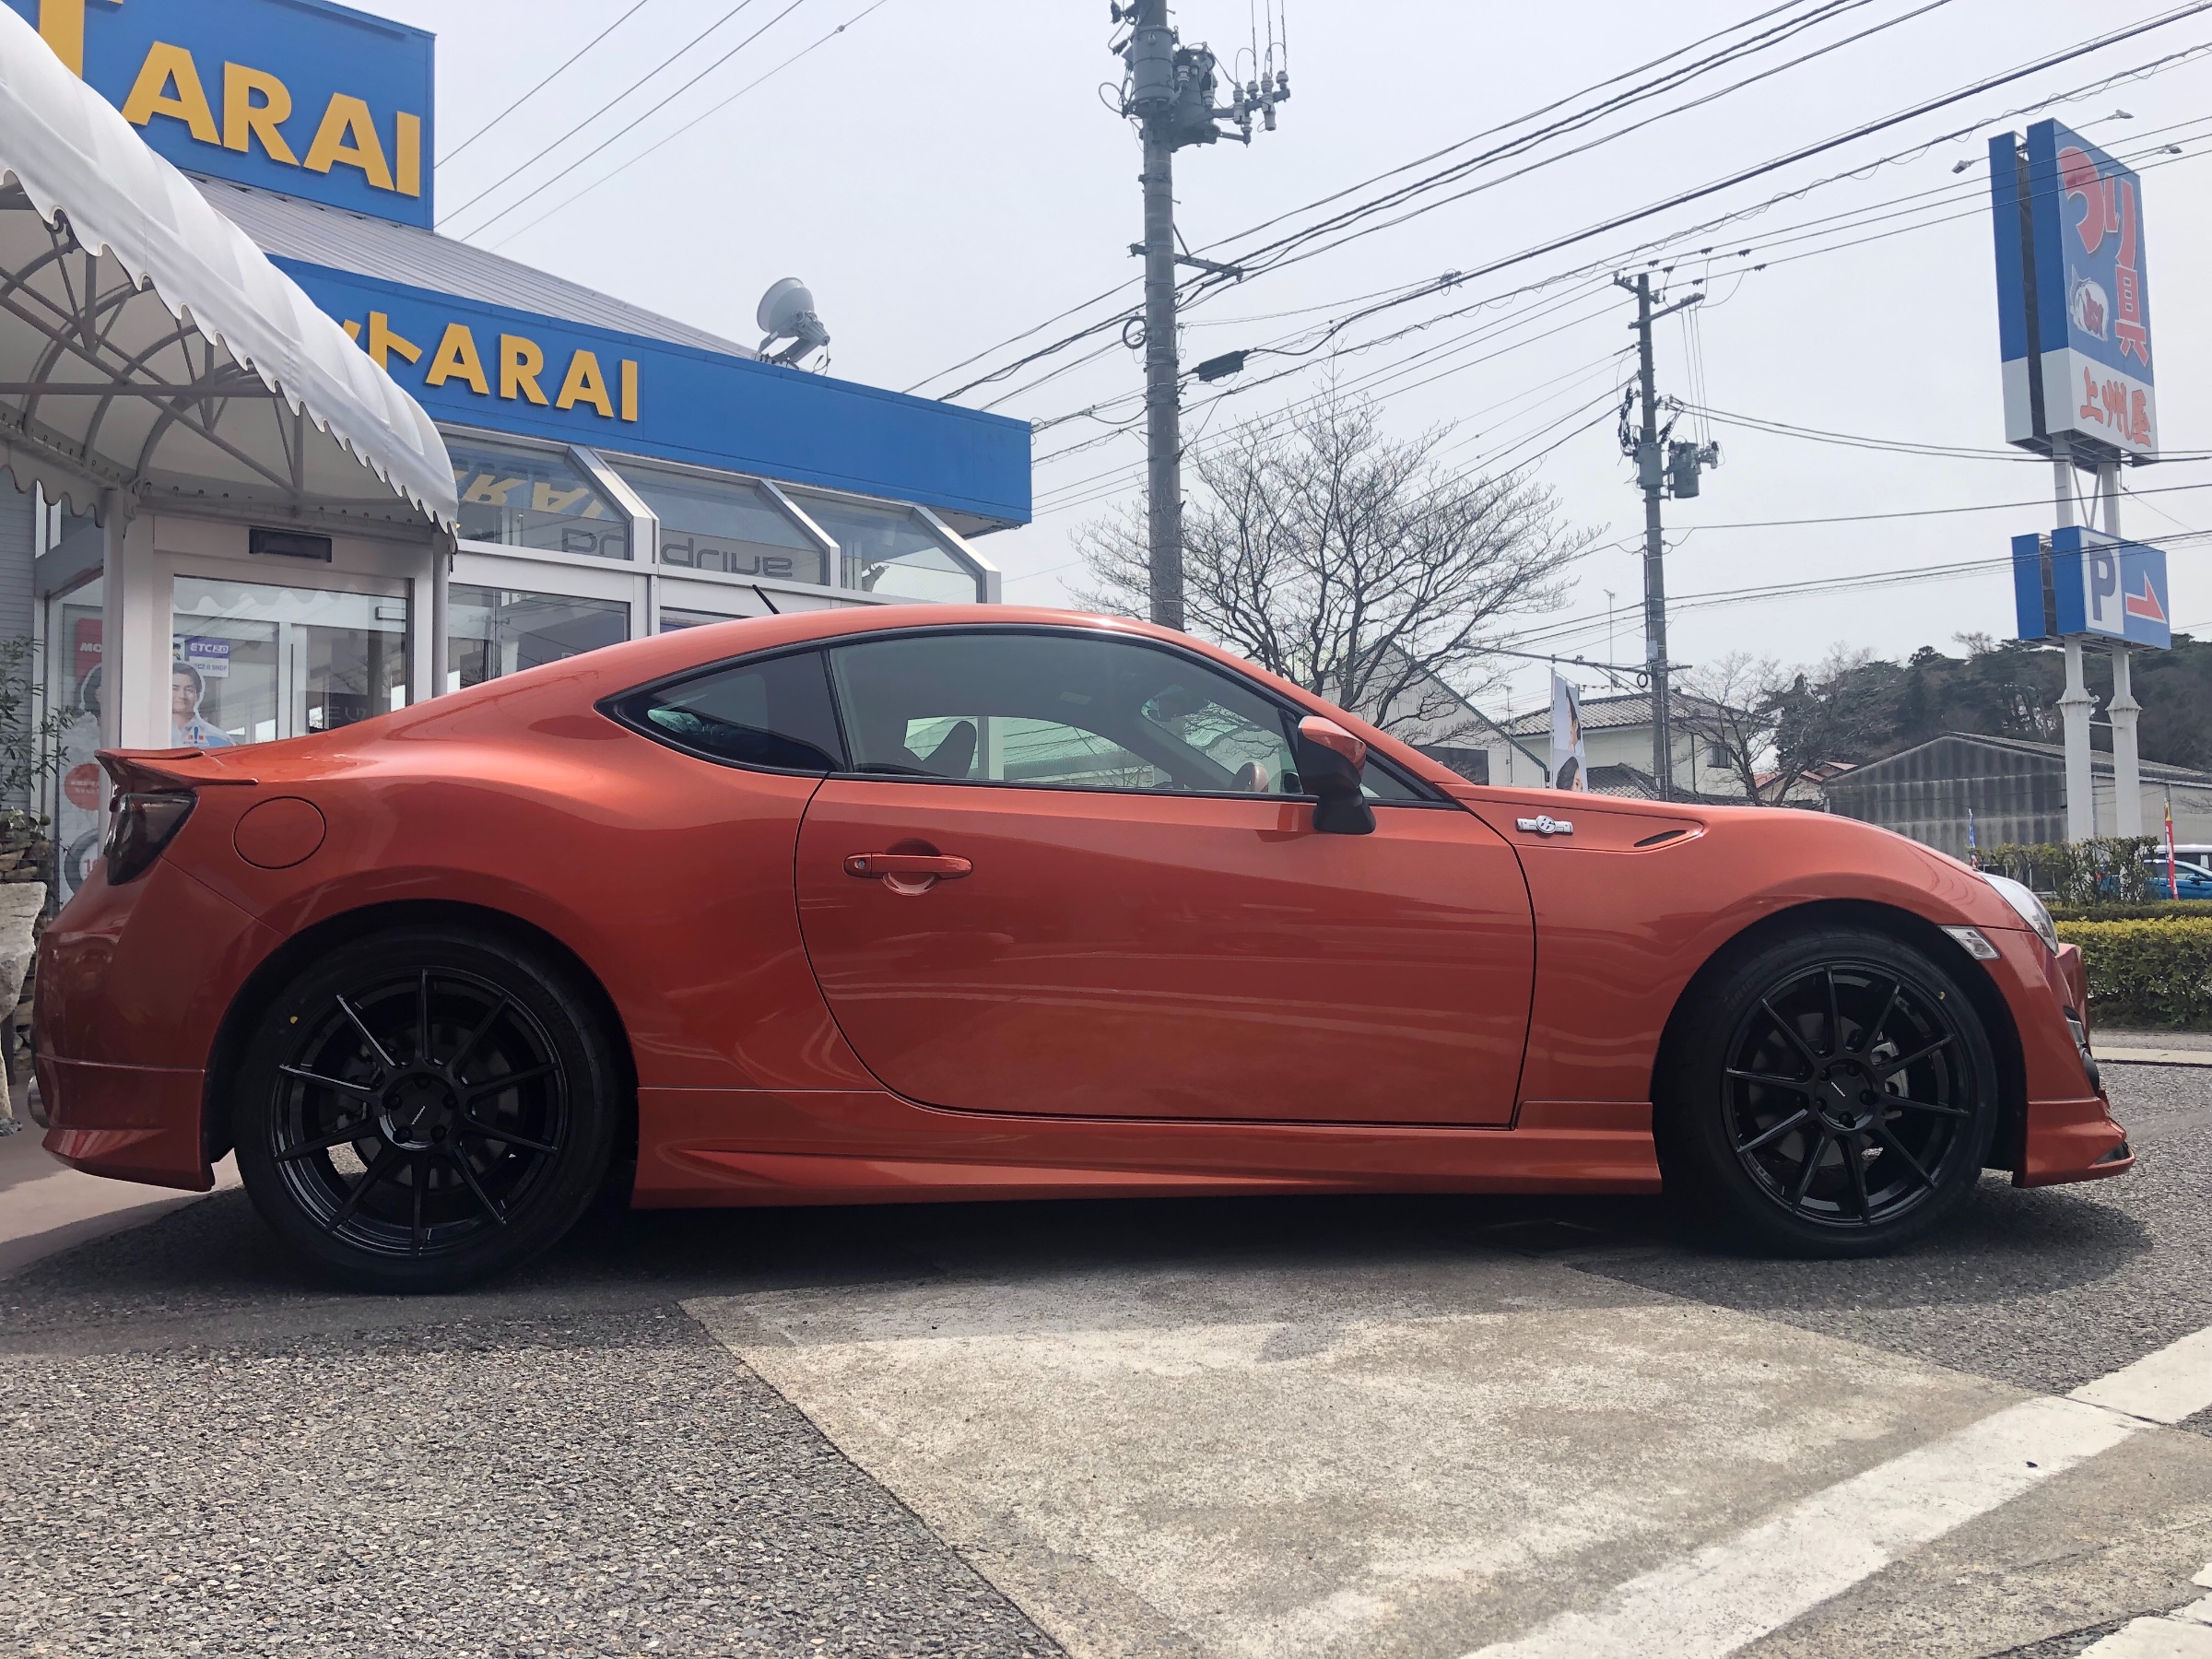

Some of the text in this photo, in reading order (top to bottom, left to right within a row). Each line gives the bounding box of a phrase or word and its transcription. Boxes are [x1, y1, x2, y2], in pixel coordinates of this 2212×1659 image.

[2080, 366, 2152, 447] 上州屋
[2088, 540, 2116, 621] P
